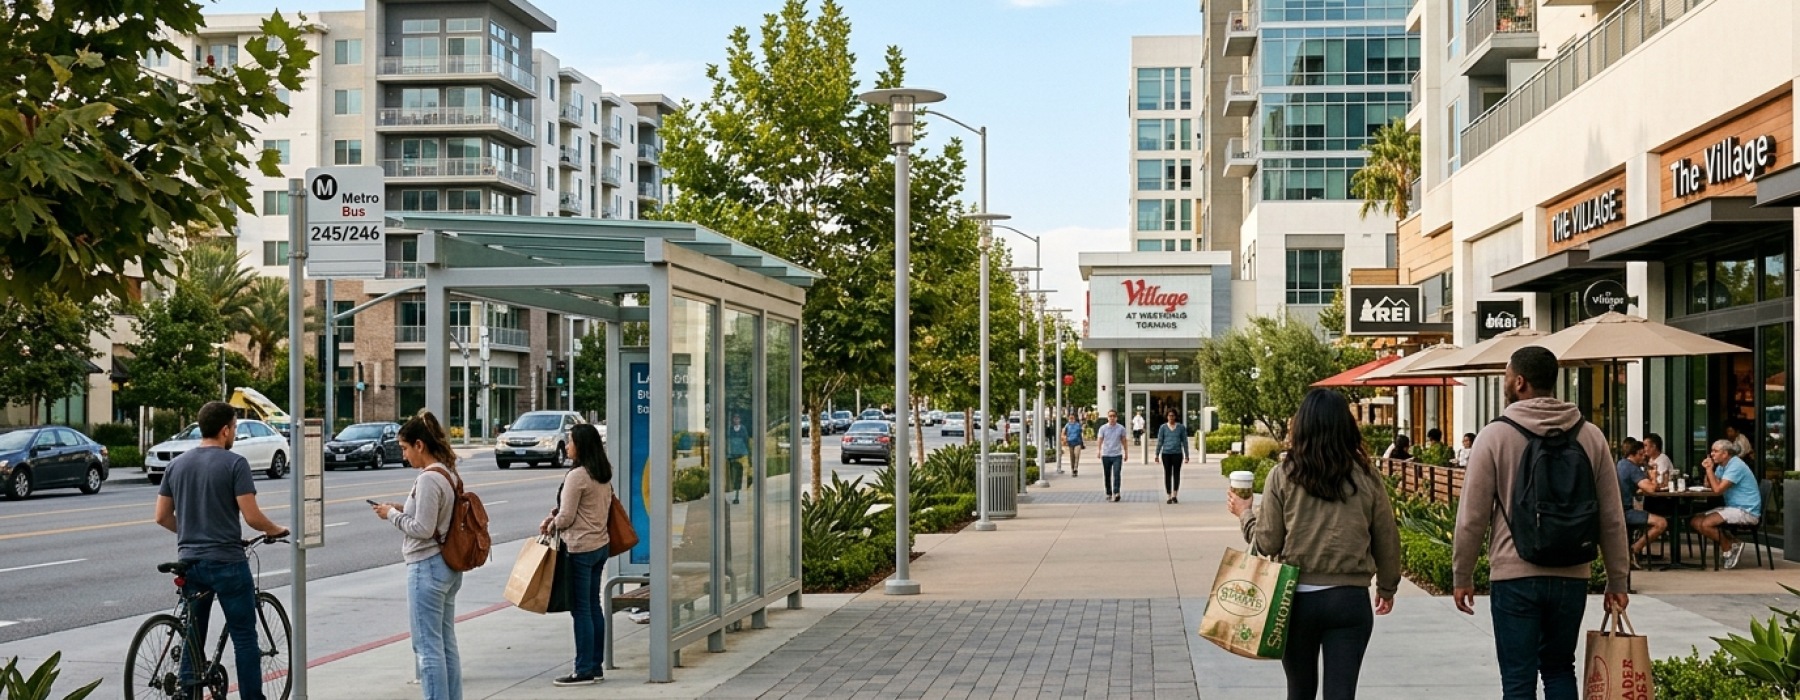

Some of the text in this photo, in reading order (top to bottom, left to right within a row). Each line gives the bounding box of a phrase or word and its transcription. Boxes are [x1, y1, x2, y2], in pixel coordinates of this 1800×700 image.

[1670, 134, 1768, 198] The Village
[317, 179, 333, 196] M
[342, 192, 379, 204] Metro
[342, 206, 366, 217] Bus
[1552, 188, 1617, 243] THE VILLAGE
[311, 225, 380, 241] 245/246
[1121, 279, 1189, 312] Village
[1376, 306, 1411, 322] REI
